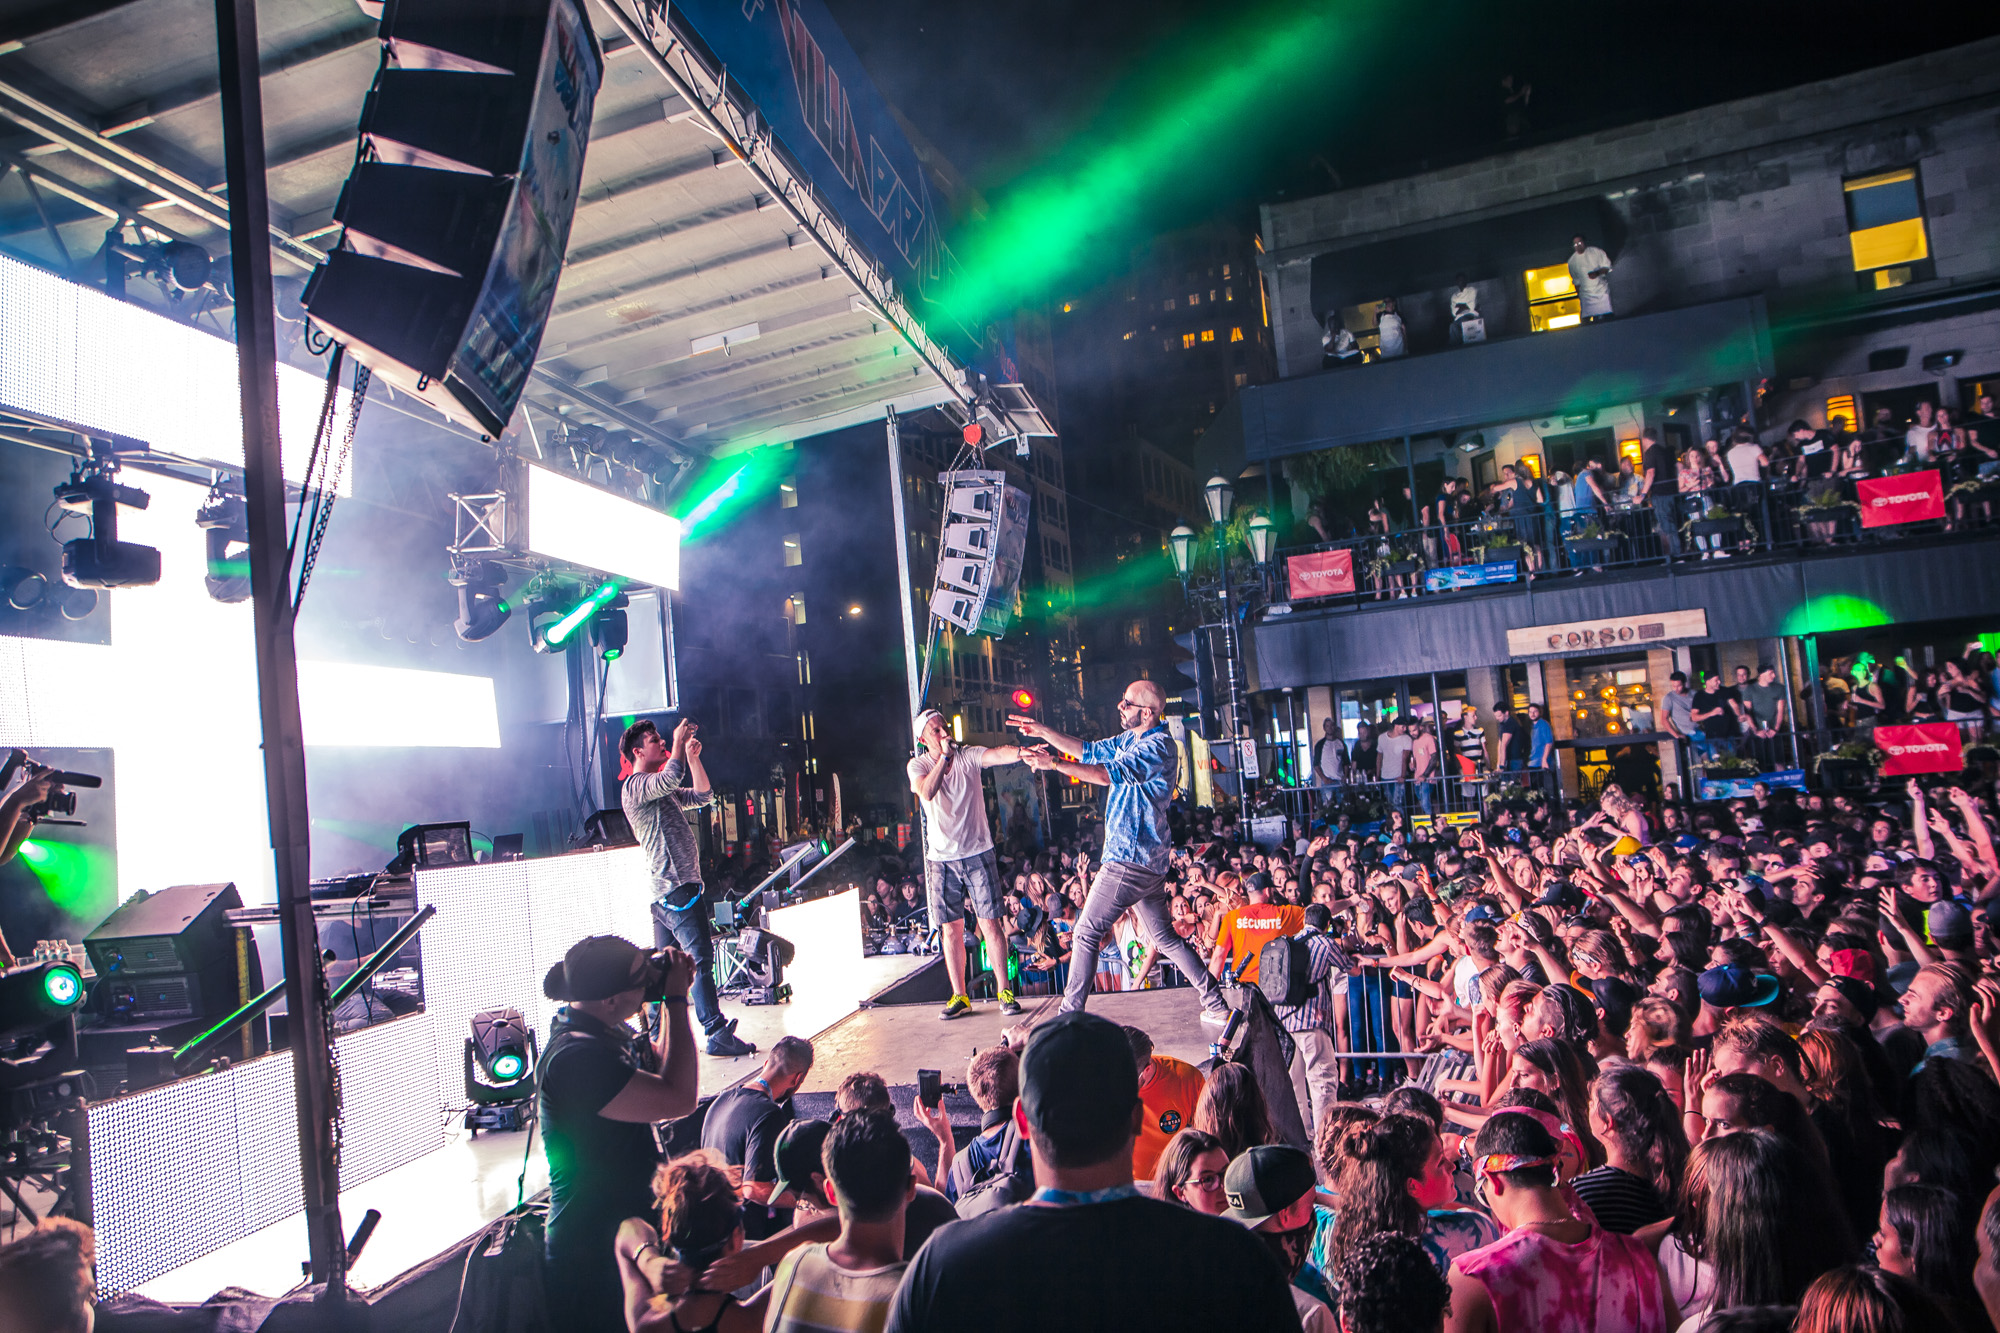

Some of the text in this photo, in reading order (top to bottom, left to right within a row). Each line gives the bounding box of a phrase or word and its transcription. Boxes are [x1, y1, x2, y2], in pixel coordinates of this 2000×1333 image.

[1887, 491, 1930, 505] TOYOTA
[1311, 568, 1344, 579] TOYOTA
[1547, 626, 1635, 649] CORSO
[1904, 743, 1950, 754] TOYOTA
[1236, 915, 1283, 930] SÉCURITÉ
